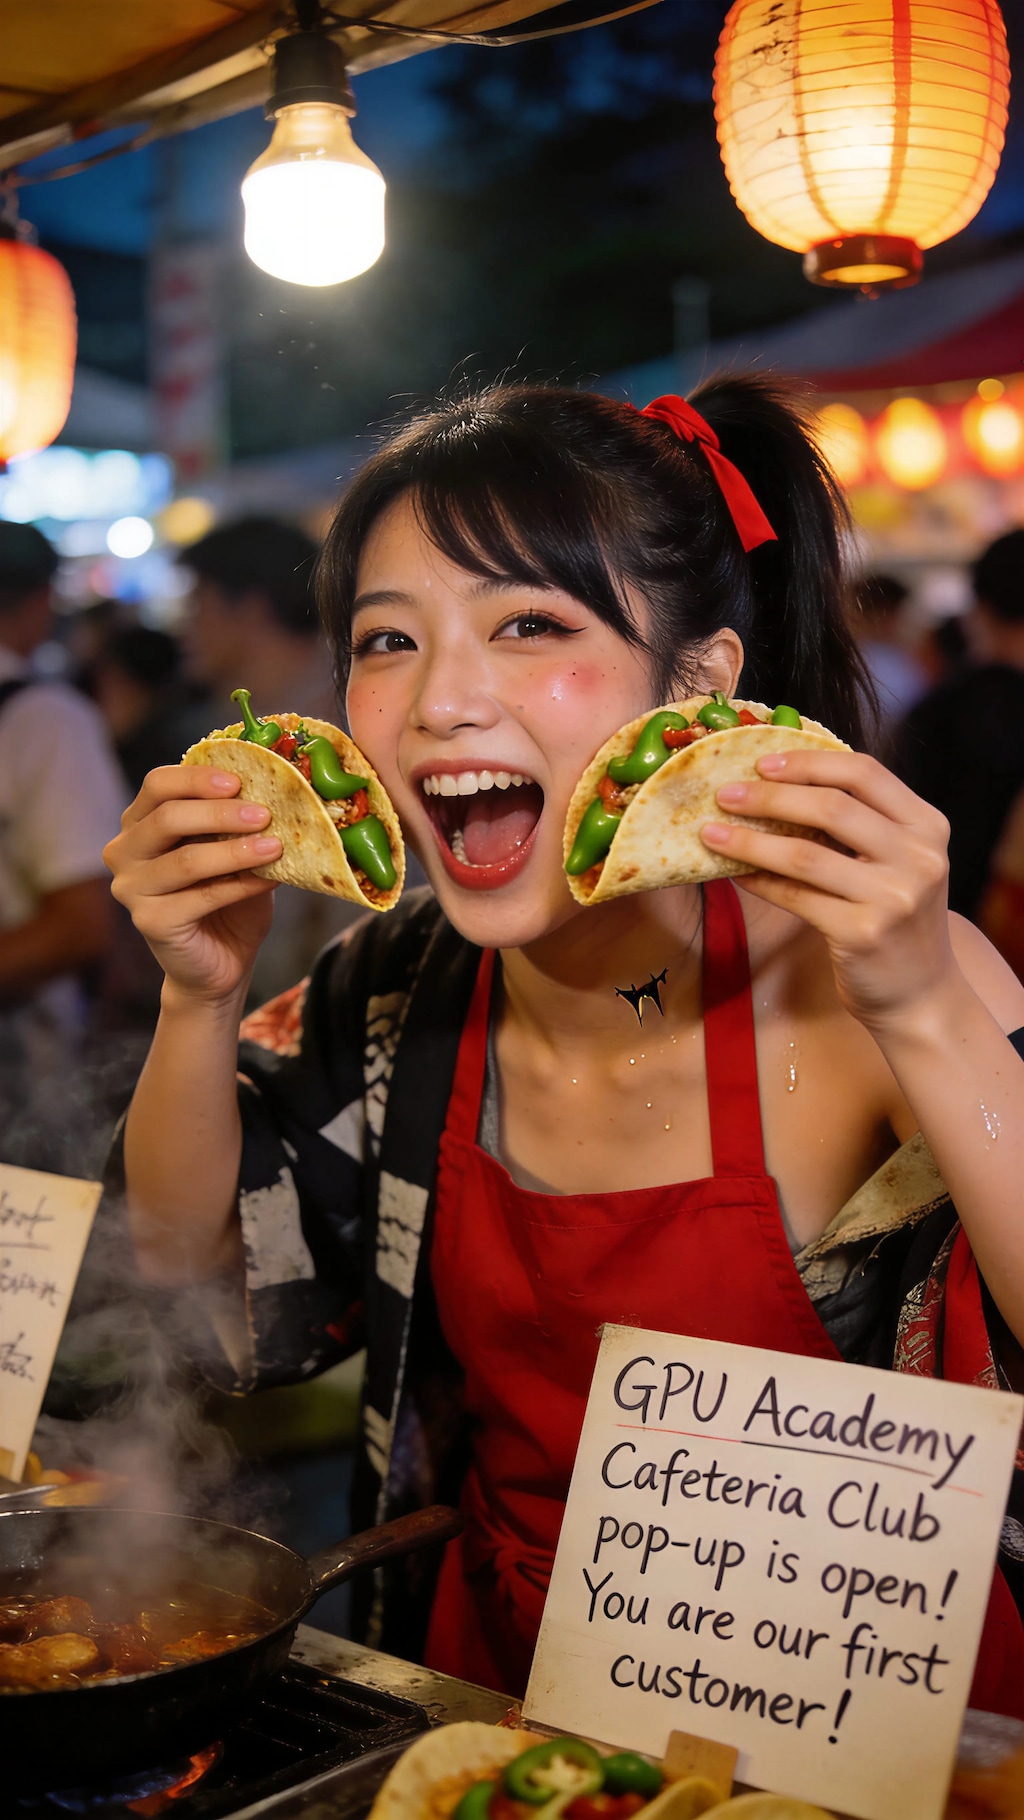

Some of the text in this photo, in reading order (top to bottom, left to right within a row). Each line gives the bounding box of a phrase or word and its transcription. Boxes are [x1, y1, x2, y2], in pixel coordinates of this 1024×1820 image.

[613, 1355, 975, 1490] GPU Academy
[600, 1441, 941, 1542] Cafeteria Club
[593, 1515, 959, 1621] pop-up is open!
[582, 1567, 950, 1695] You are our first
[609, 1654, 852, 1744] customer!
